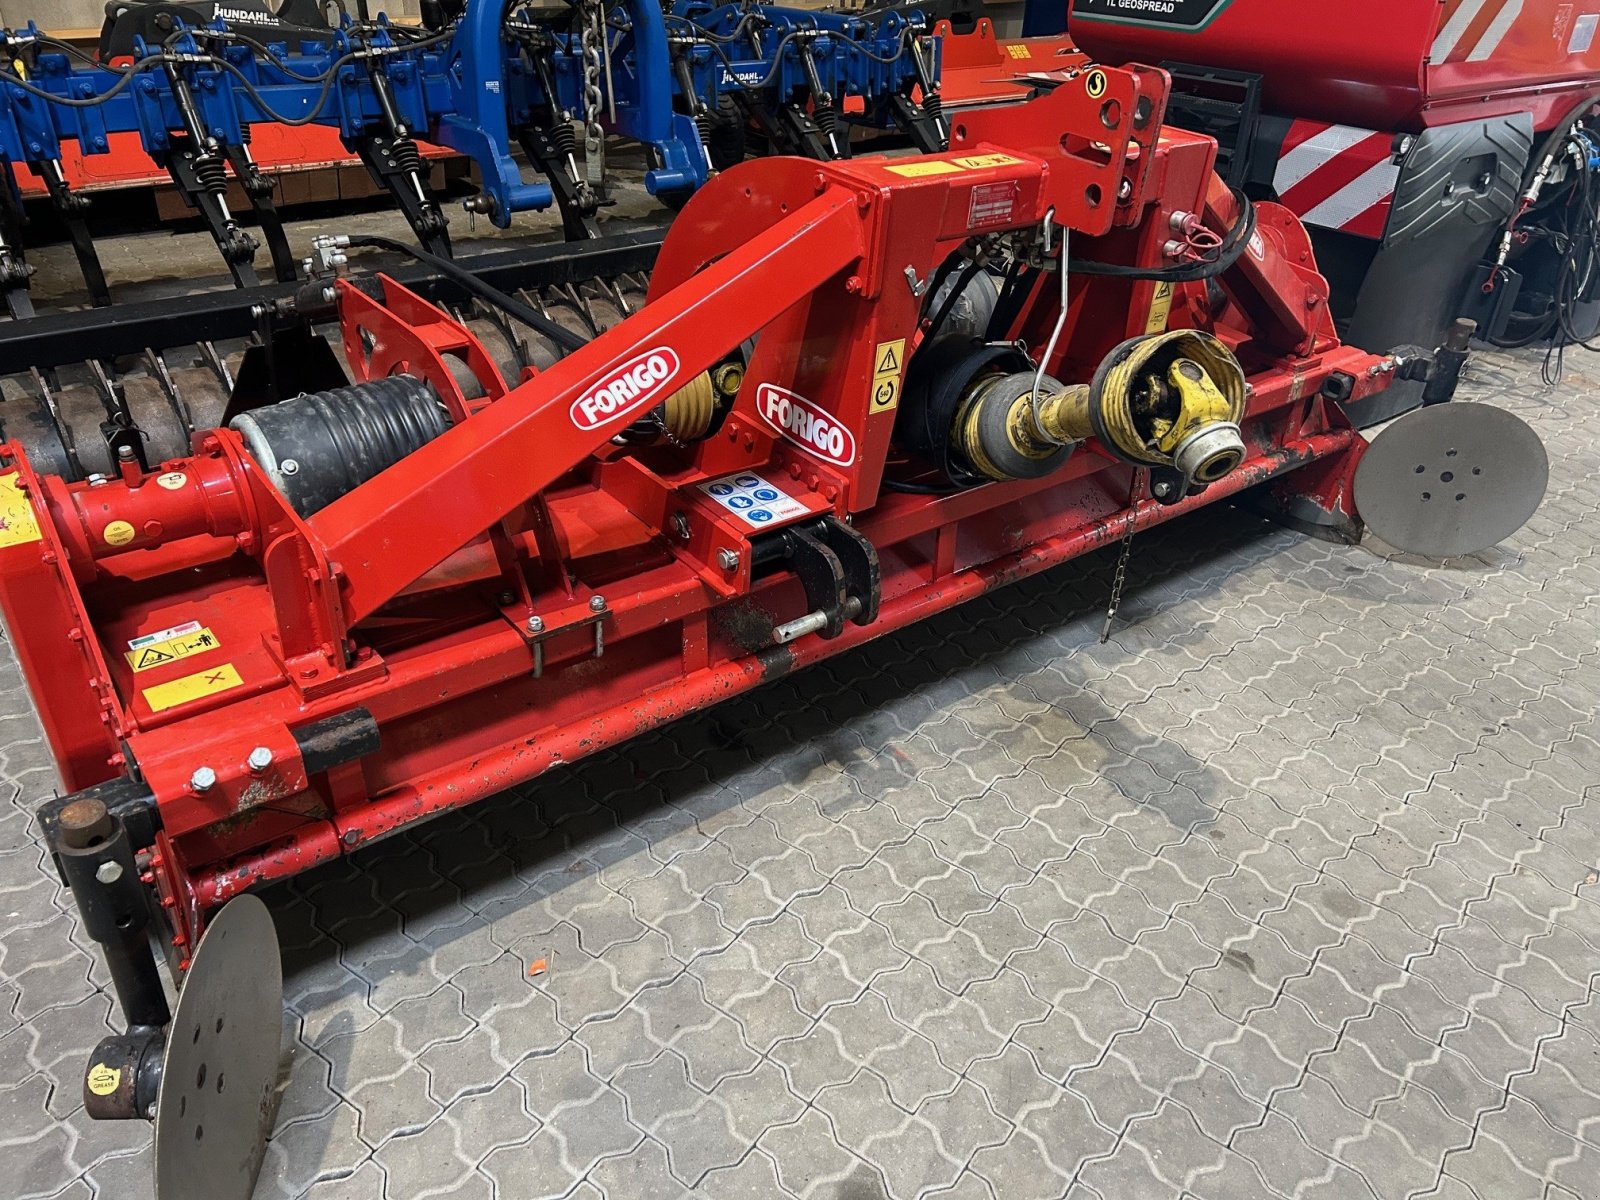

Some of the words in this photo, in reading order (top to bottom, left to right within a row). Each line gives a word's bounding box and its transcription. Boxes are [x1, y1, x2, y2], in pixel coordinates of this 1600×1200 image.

[1118, 0, 1175, 13] GEOSPREAD
[579, 355, 668, 424] FORIGO
[766, 389, 845, 457] FORIGO
[93, 1081, 114, 1089] GREASE
